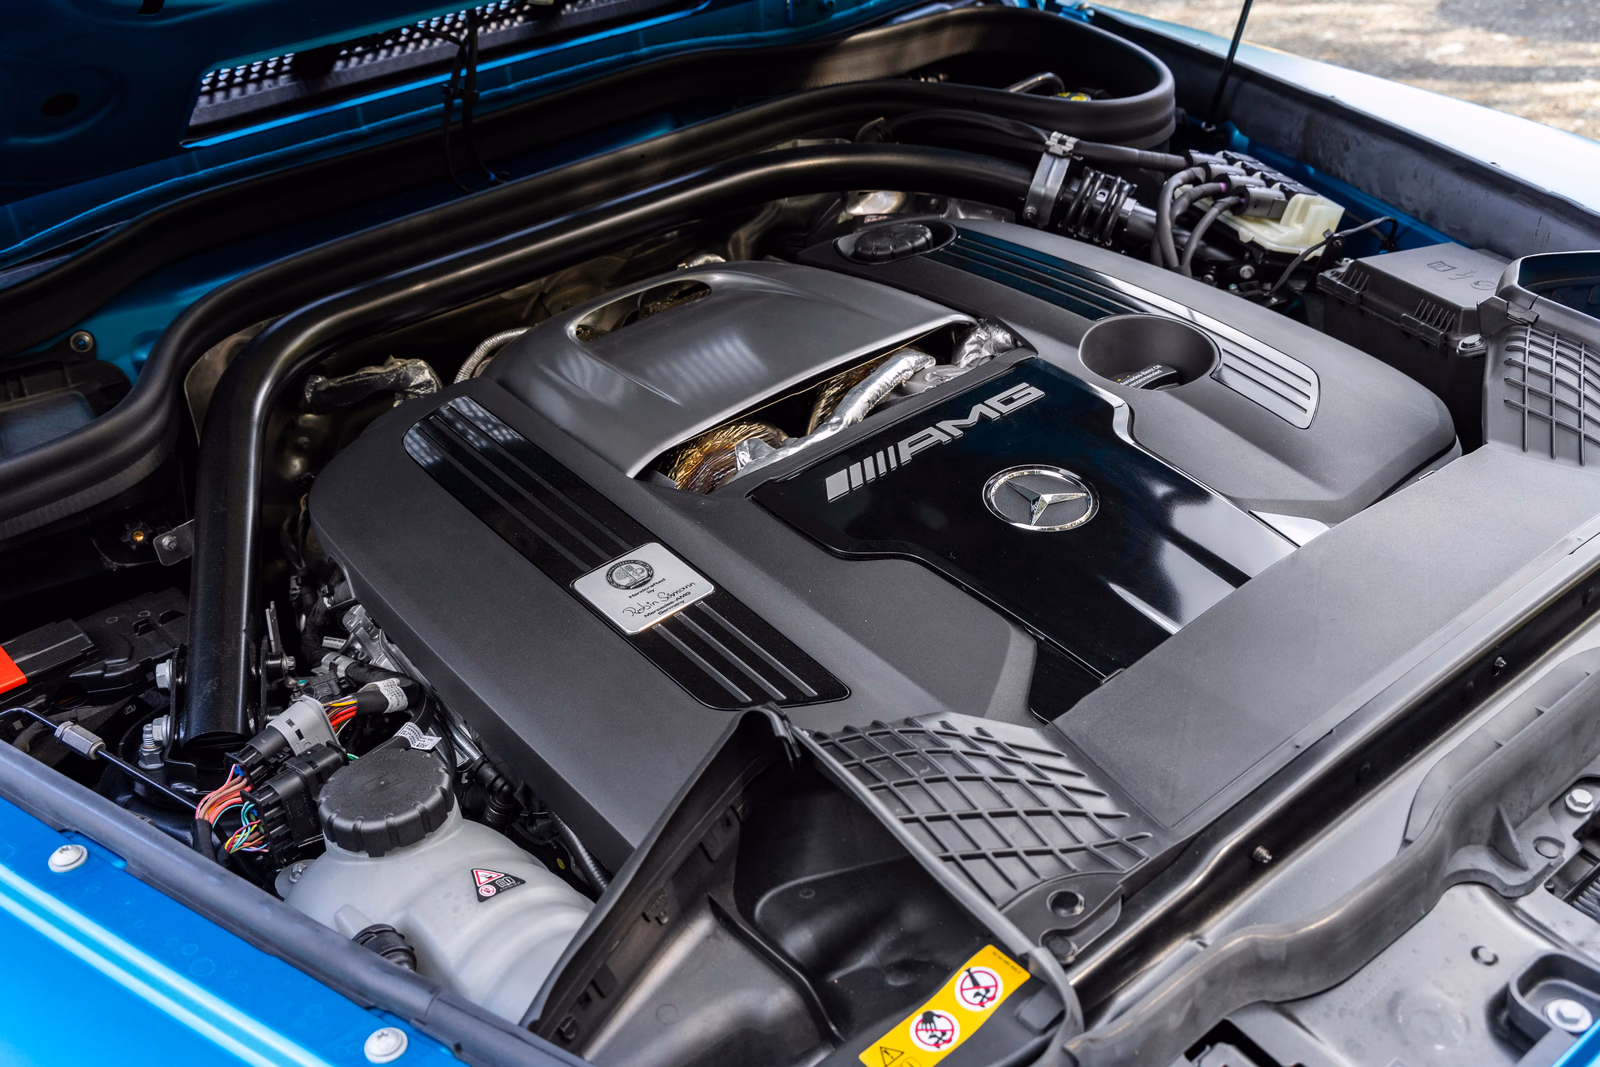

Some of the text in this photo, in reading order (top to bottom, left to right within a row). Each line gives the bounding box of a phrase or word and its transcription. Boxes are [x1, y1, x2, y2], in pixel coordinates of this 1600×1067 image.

[898, 382, 1045, 466] AMG
[628, 578, 666, 599] Handcrafted
[622, 600, 660, 617] Robin
[644, 591, 691, 618] Mercedes-AMG
[658, 600, 685, 615] Germany
